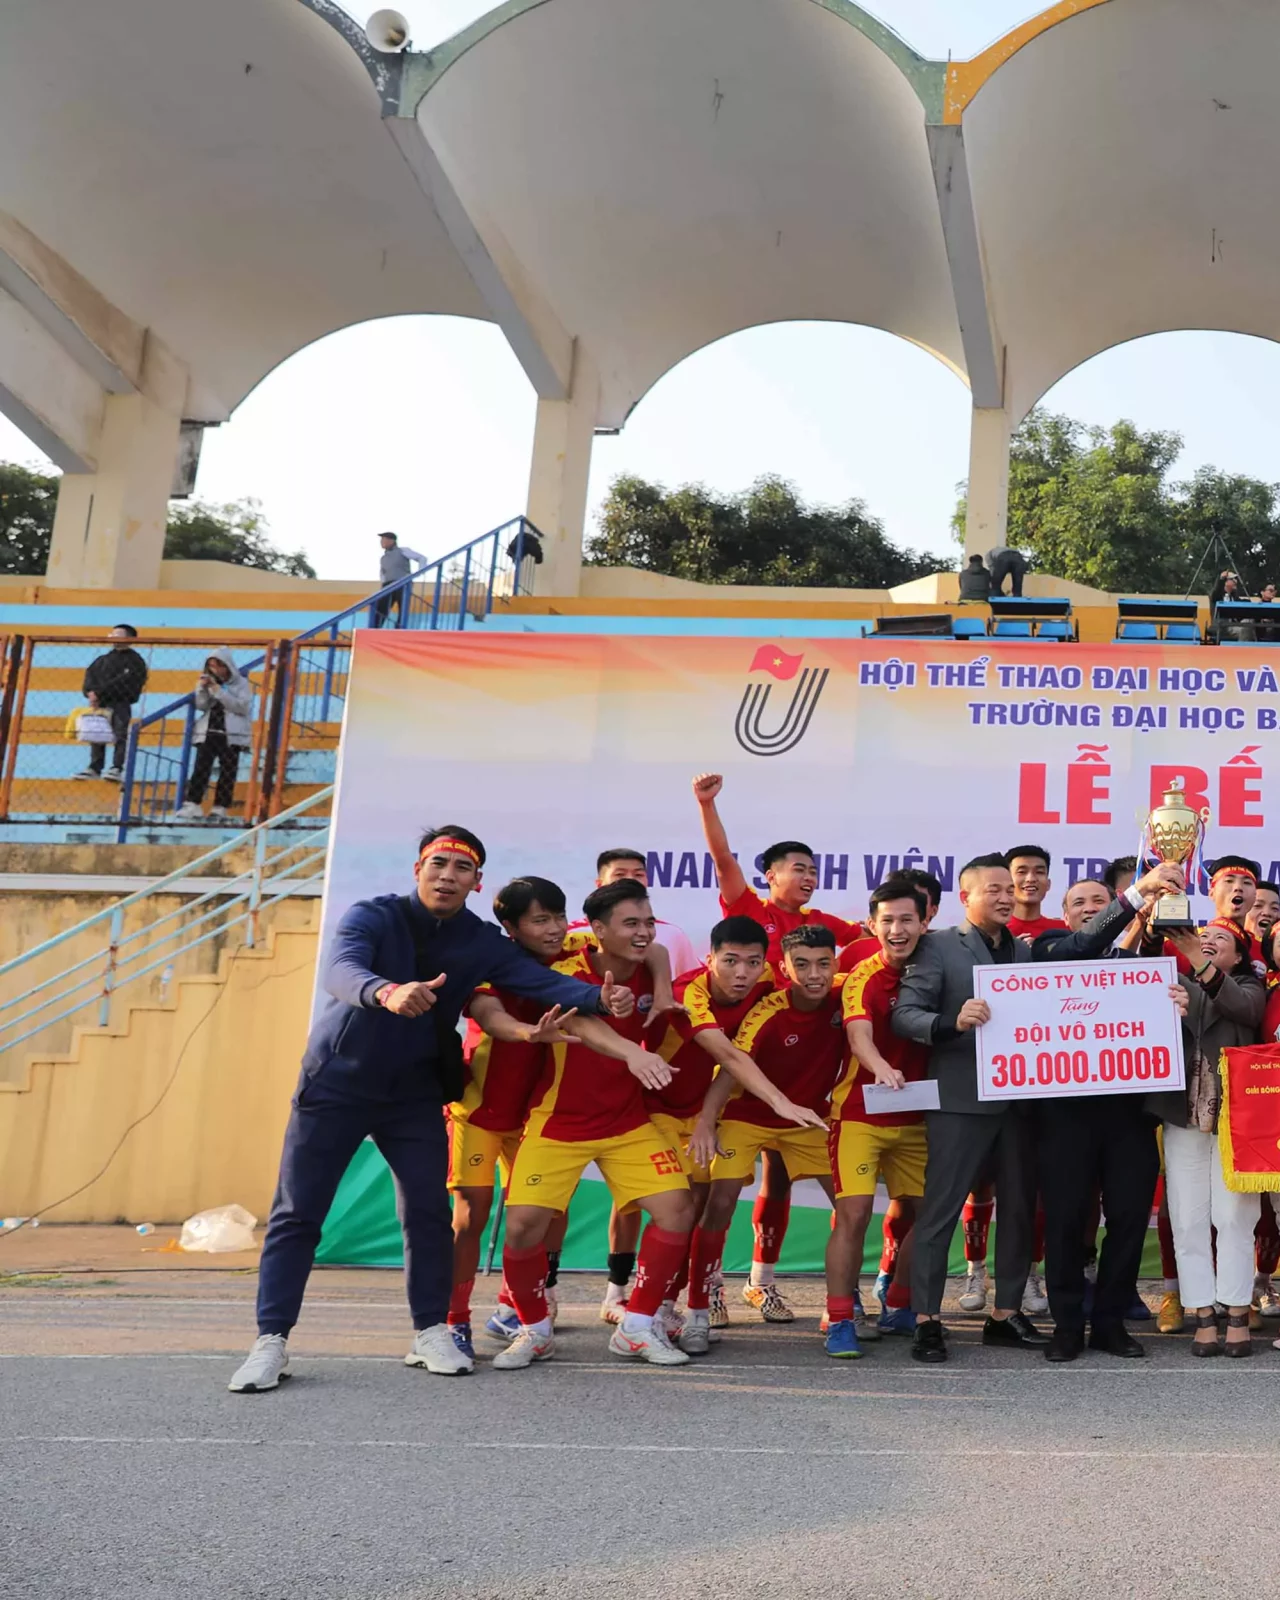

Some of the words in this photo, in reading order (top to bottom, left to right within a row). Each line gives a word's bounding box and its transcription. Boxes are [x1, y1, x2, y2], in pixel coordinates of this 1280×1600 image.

[860, 659, 915, 690] HỘI
[927, 656, 990, 688] THỂ
[998, 665, 1081, 690] THAO
[1092, 667, 1148, 694] ĐẠI
[1159, 668, 1225, 696] HỌC
[1236, 664, 1278, 693] VÀ
[969, 699, 1101, 727] TRƯỜNG
[1111, 705, 1167, 732] ĐẠI
[1179, 706, 1245, 734] HỌC
[1018, 743, 1112, 825] LỄ
[1150, 745, 1264, 827] BẾ
[991, 974, 1048, 993] CÔNG
[1054, 974, 1074, 989] TY
[1080, 969, 1117, 990] VIỆT
[1123, 970, 1163, 985] HOA
[1014, 1022, 1050, 1046] ĐỘI
[1058, 1021, 1086, 1041] VÔ
[1093, 1021, 1145, 1042] ĐỊCH
[991, 1045, 1171, 1088] 30.000.000Đ
